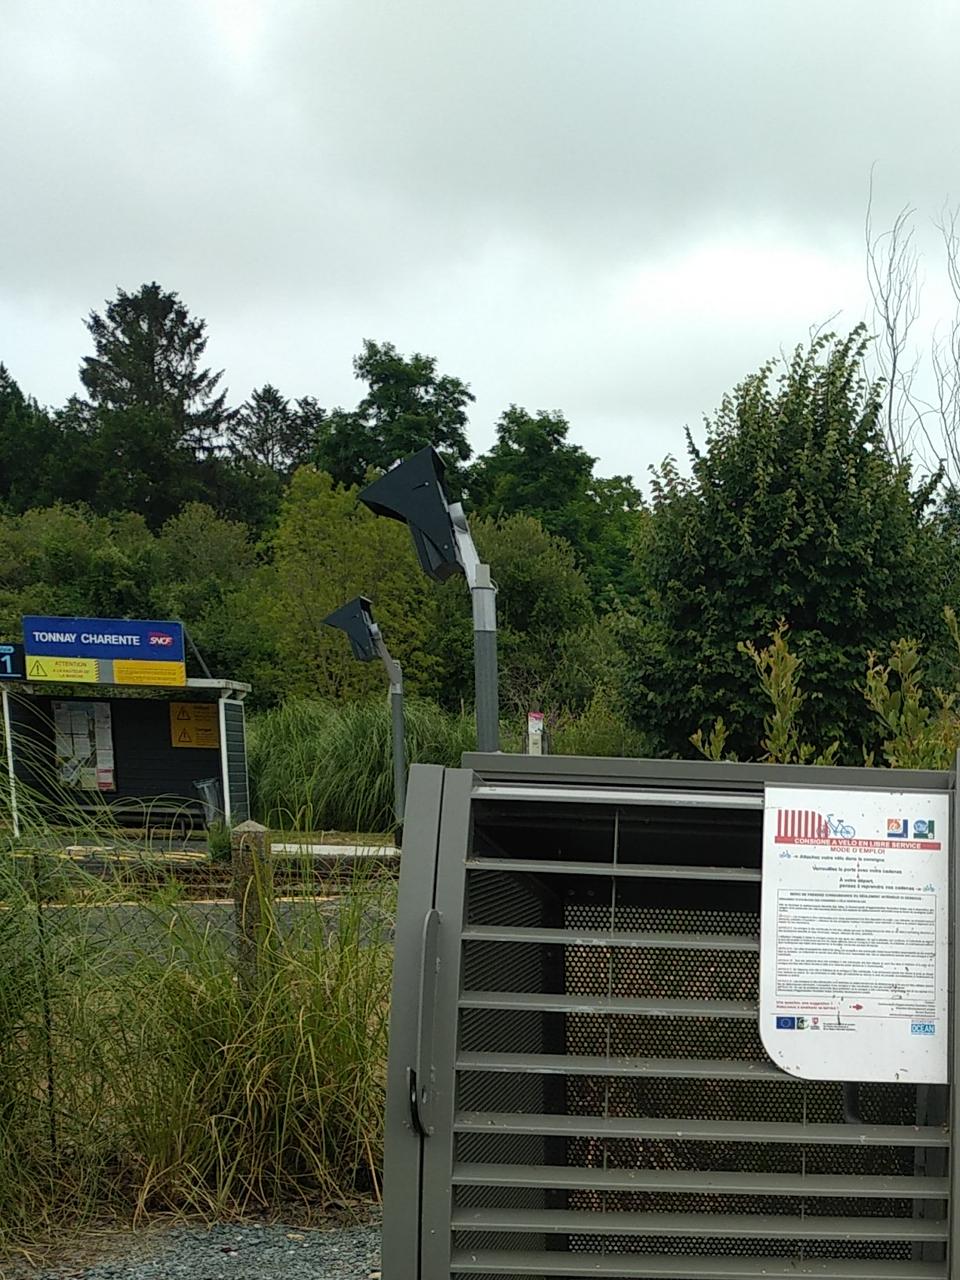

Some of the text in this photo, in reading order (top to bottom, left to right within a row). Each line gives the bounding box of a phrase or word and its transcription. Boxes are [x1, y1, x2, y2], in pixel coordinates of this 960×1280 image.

[33, 631, 141, 646] TONNAY CHARENTE
[149, 636, 173, 645] SNCF
[1, 655, 12, 673] 1
